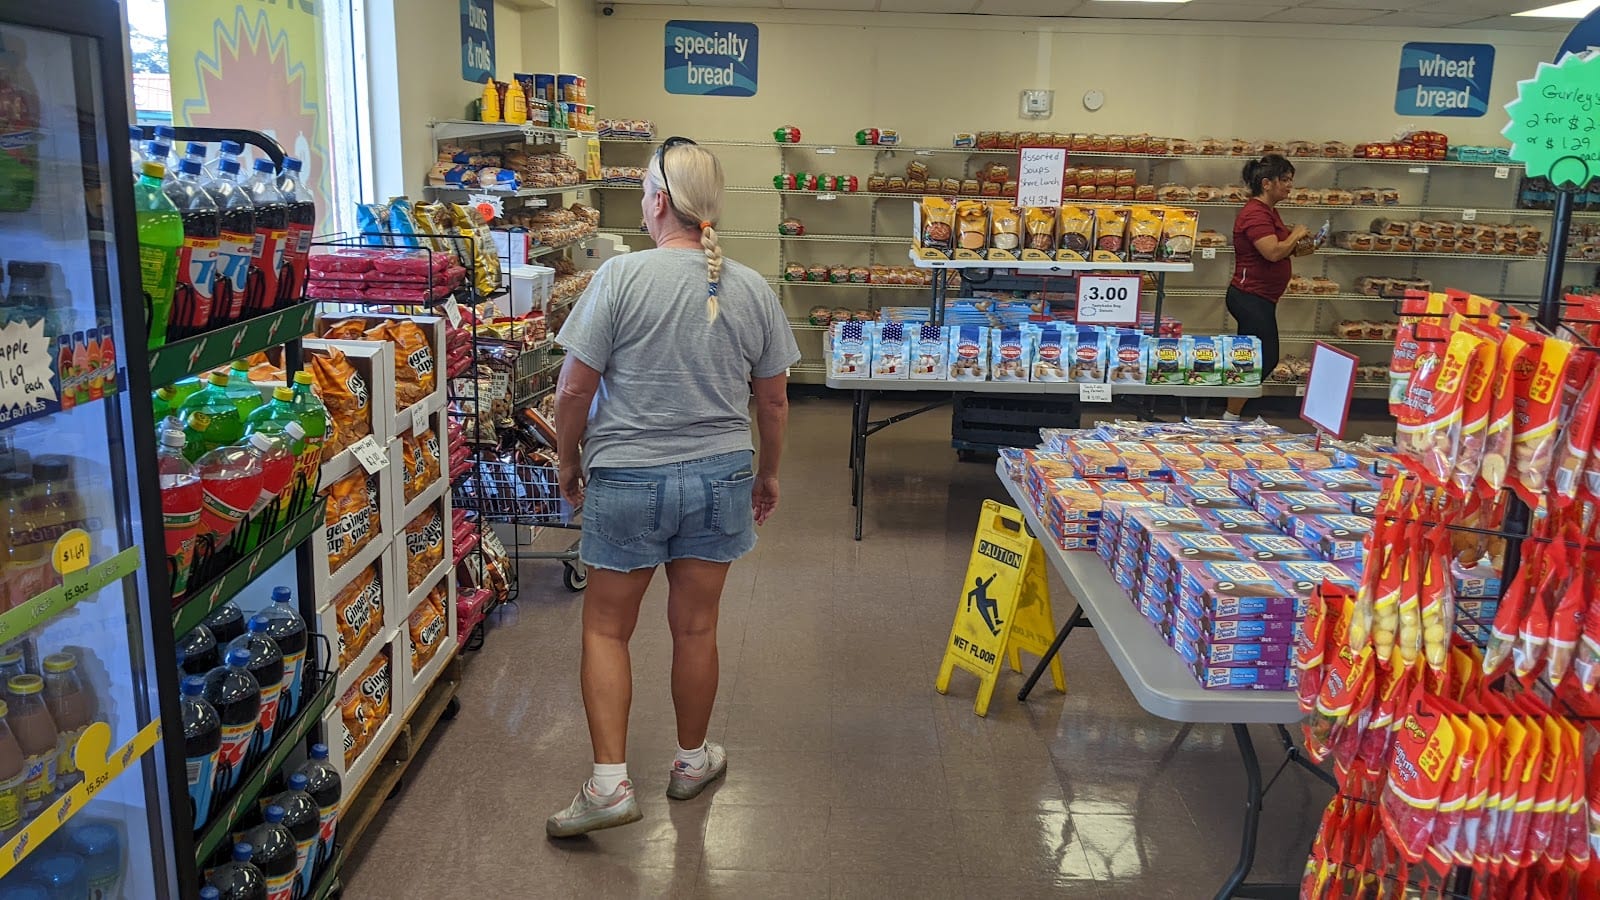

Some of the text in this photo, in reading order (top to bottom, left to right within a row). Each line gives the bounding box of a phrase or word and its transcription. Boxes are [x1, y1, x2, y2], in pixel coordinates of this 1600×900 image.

[469, 0, 487, 31] buns
[467, 35, 490, 71] & rolls
[674, 31, 748, 62] specialty
[687, 60, 734, 86] bread
[1418, 53, 1476, 78] wheat
[1415, 84, 1470, 108] bread
[1526, 113, 1539, 128] 2
[1544, 112, 1564, 124] for
[1022, 151, 1060, 162] Assorted
[1023, 165, 1050, 175] Soups
[1089, 286, 1128, 301] 3.00
[25, 377, 45, 394] each
[340, 508, 371, 533] Ginger
[979, 541, 1022, 566] CAUTION
[344, 592, 367, 625] Ginger
[952, 635, 996, 665] WET FLOOR
[85, 771, 110, 796] 15.5oz
